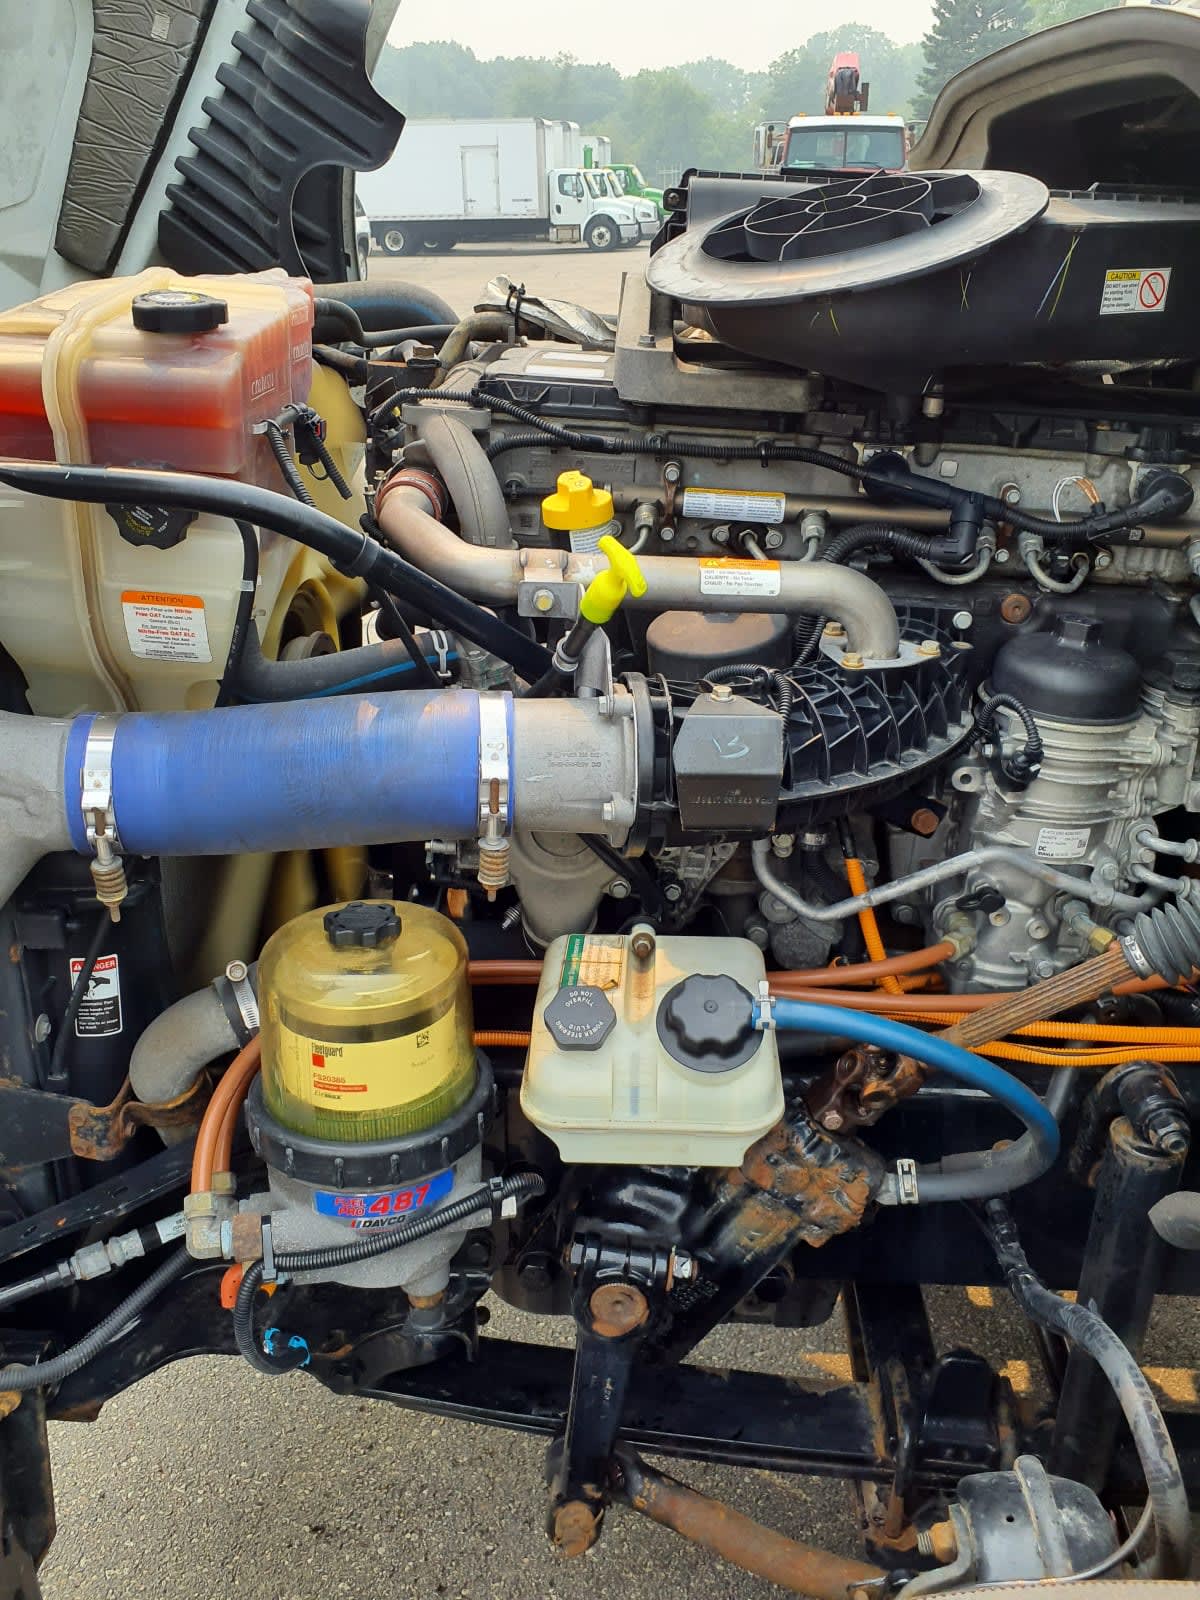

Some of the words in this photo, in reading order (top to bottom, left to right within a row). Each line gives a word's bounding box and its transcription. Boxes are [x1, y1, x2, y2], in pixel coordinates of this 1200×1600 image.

[141, 595, 184, 604] ATTENTION
[565, 997, 594, 1007] OVERFILL
[556, 1020, 583, 1038] STEERING
[568, 1023, 591, 1031] FLUID
[584, 1021, 604, 1037] POWER
[312, 1042, 343, 1058] Fleetguard
[334, 1197, 366, 1207] FUEL
[368, 1183, 430, 1214] 487
[338, 1206, 366, 1216] PRO
[362, 1215, 406, 1228] DAVCO
